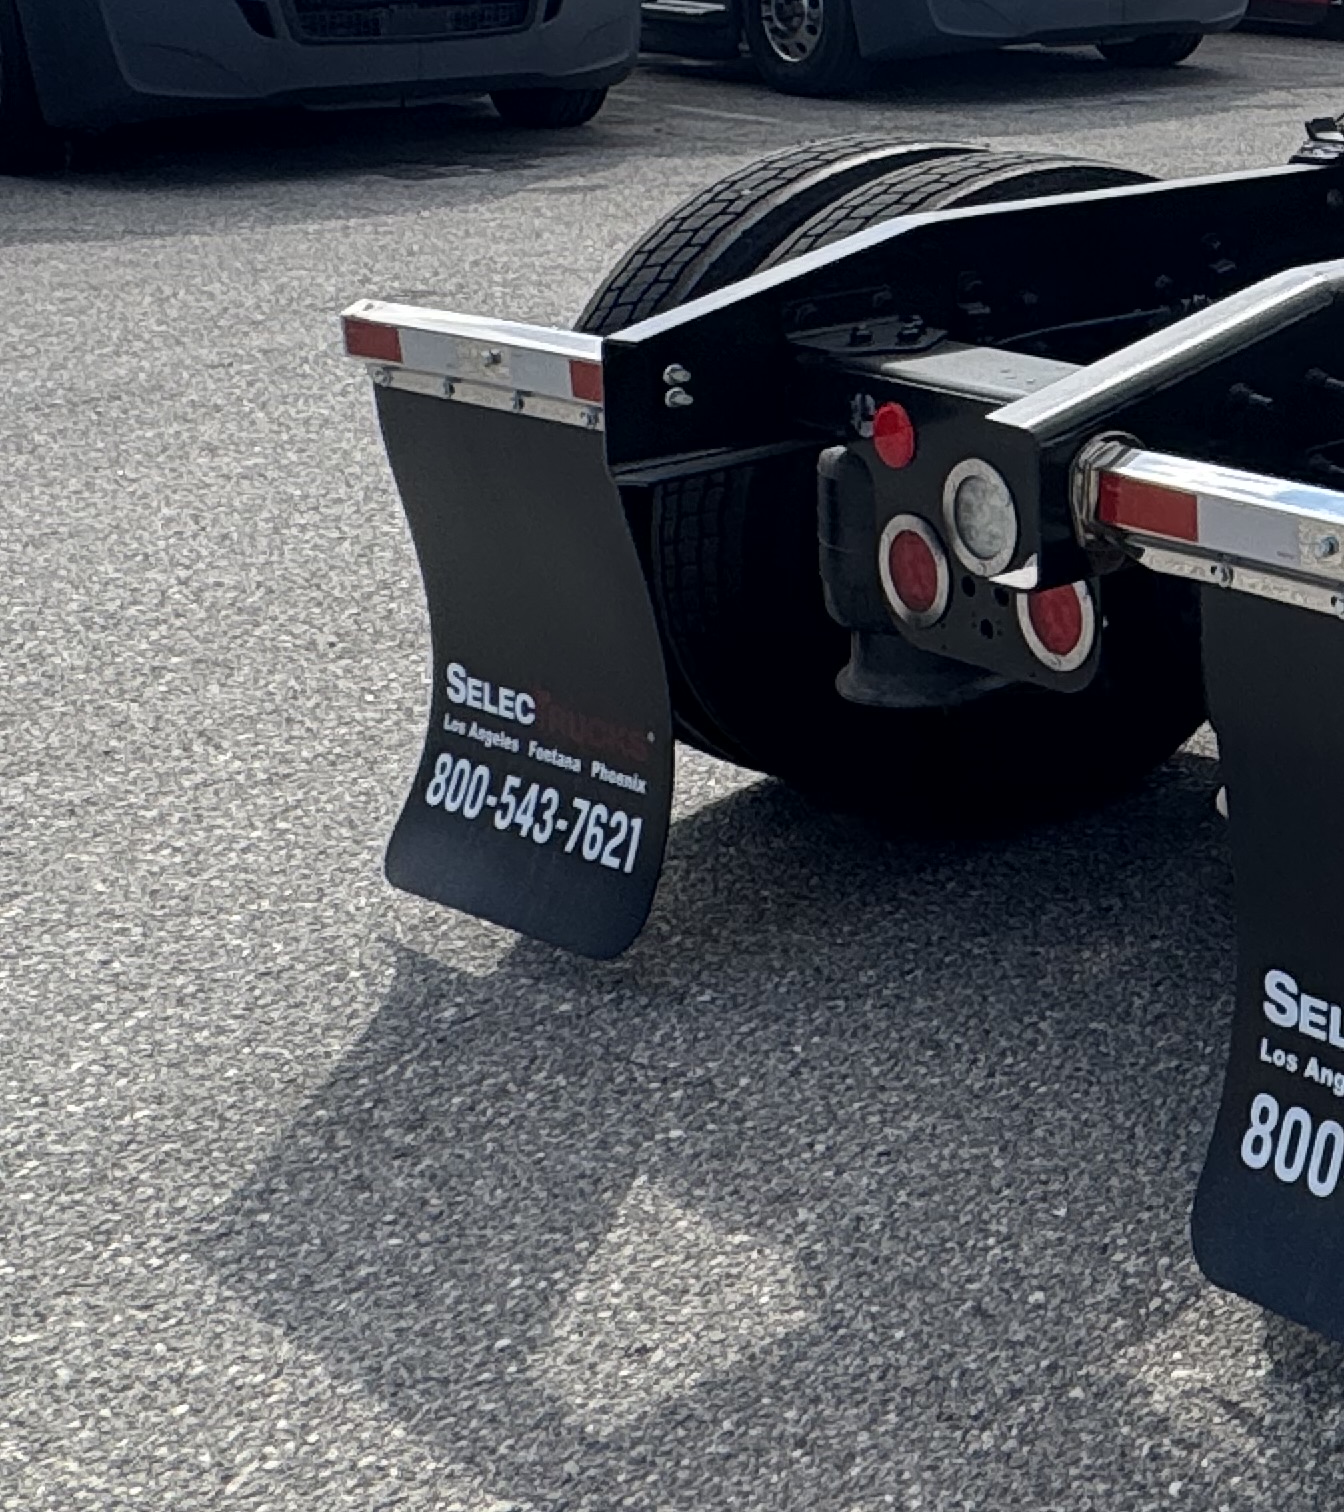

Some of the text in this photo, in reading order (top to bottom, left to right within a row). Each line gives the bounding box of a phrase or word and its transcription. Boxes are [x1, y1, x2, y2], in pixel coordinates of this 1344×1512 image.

[443, 713, 647, 794] Los Angeles Fontana Phoenix
[425, 752, 643, 874] 800-543-7621
[1259, 1038, 1298, 1072] Los
